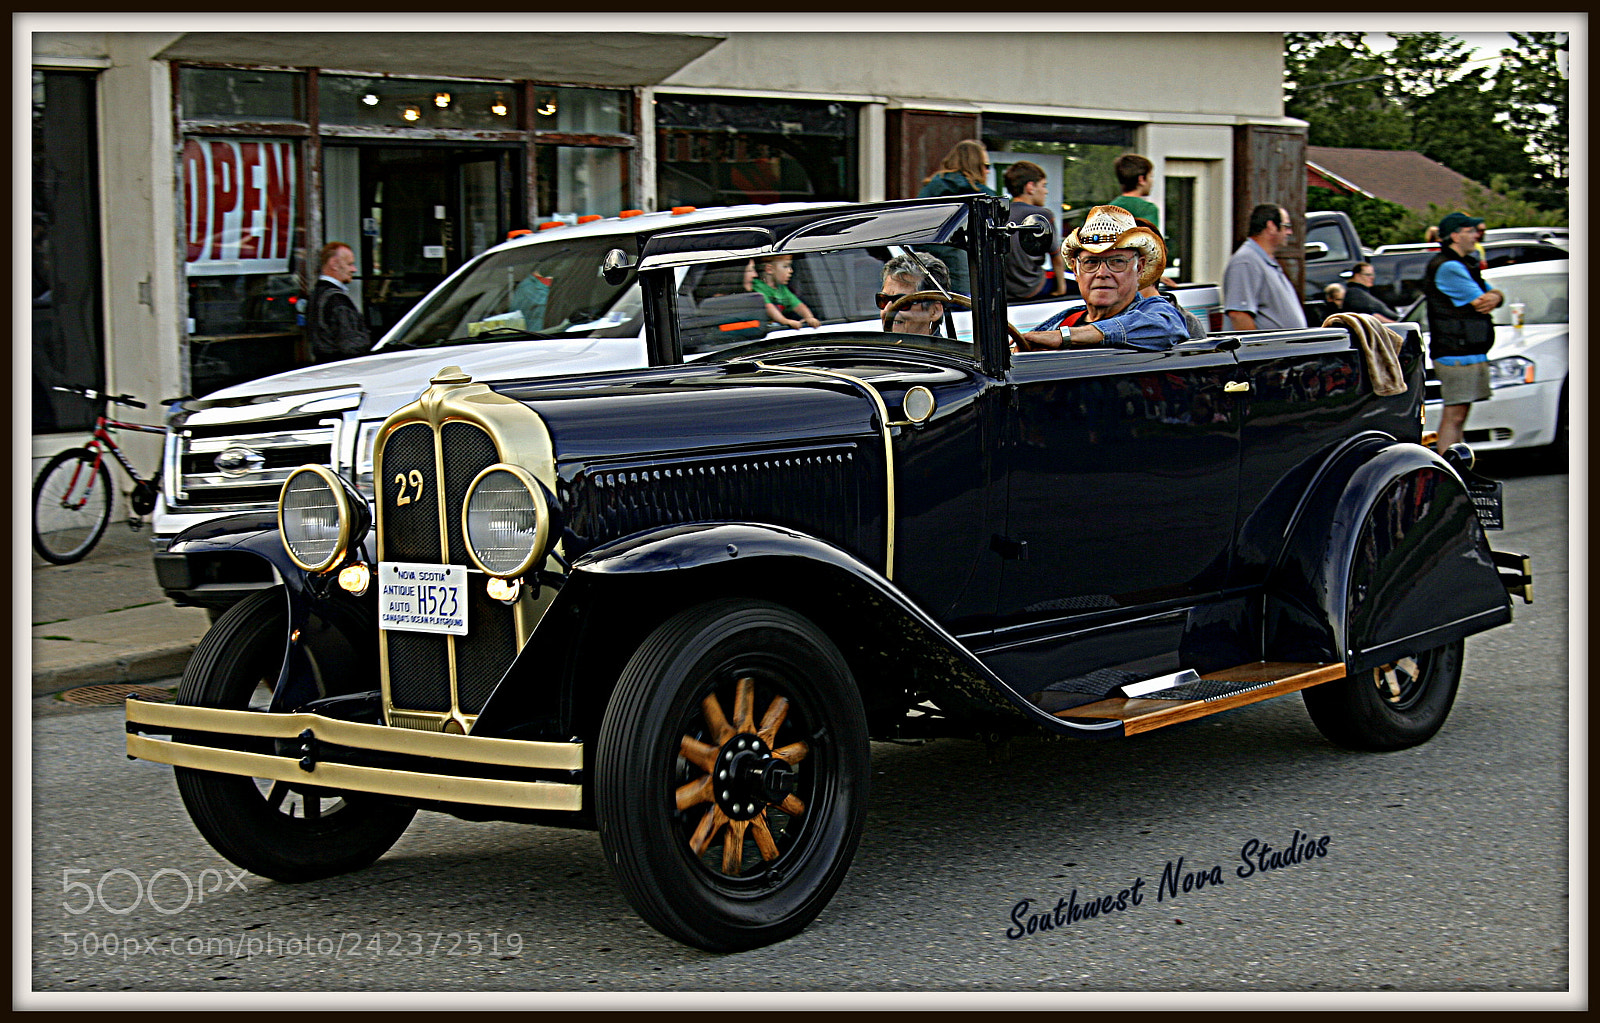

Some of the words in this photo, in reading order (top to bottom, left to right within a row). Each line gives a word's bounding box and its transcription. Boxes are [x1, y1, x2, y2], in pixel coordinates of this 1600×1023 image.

[183, 138, 290, 263] OPEN
[394, 469, 424, 507] 29
[398, 571, 416, 580] NOVA
[419, 571, 446, 582] SCOTIA
[383, 584, 415, 596] ANTIQUE
[417, 584, 458, 617] H523
[389, 601, 410, 613] AUTO
[410, 615, 429, 624] OCEAN
[429, 616, 463, 627] PLAYGROUND
